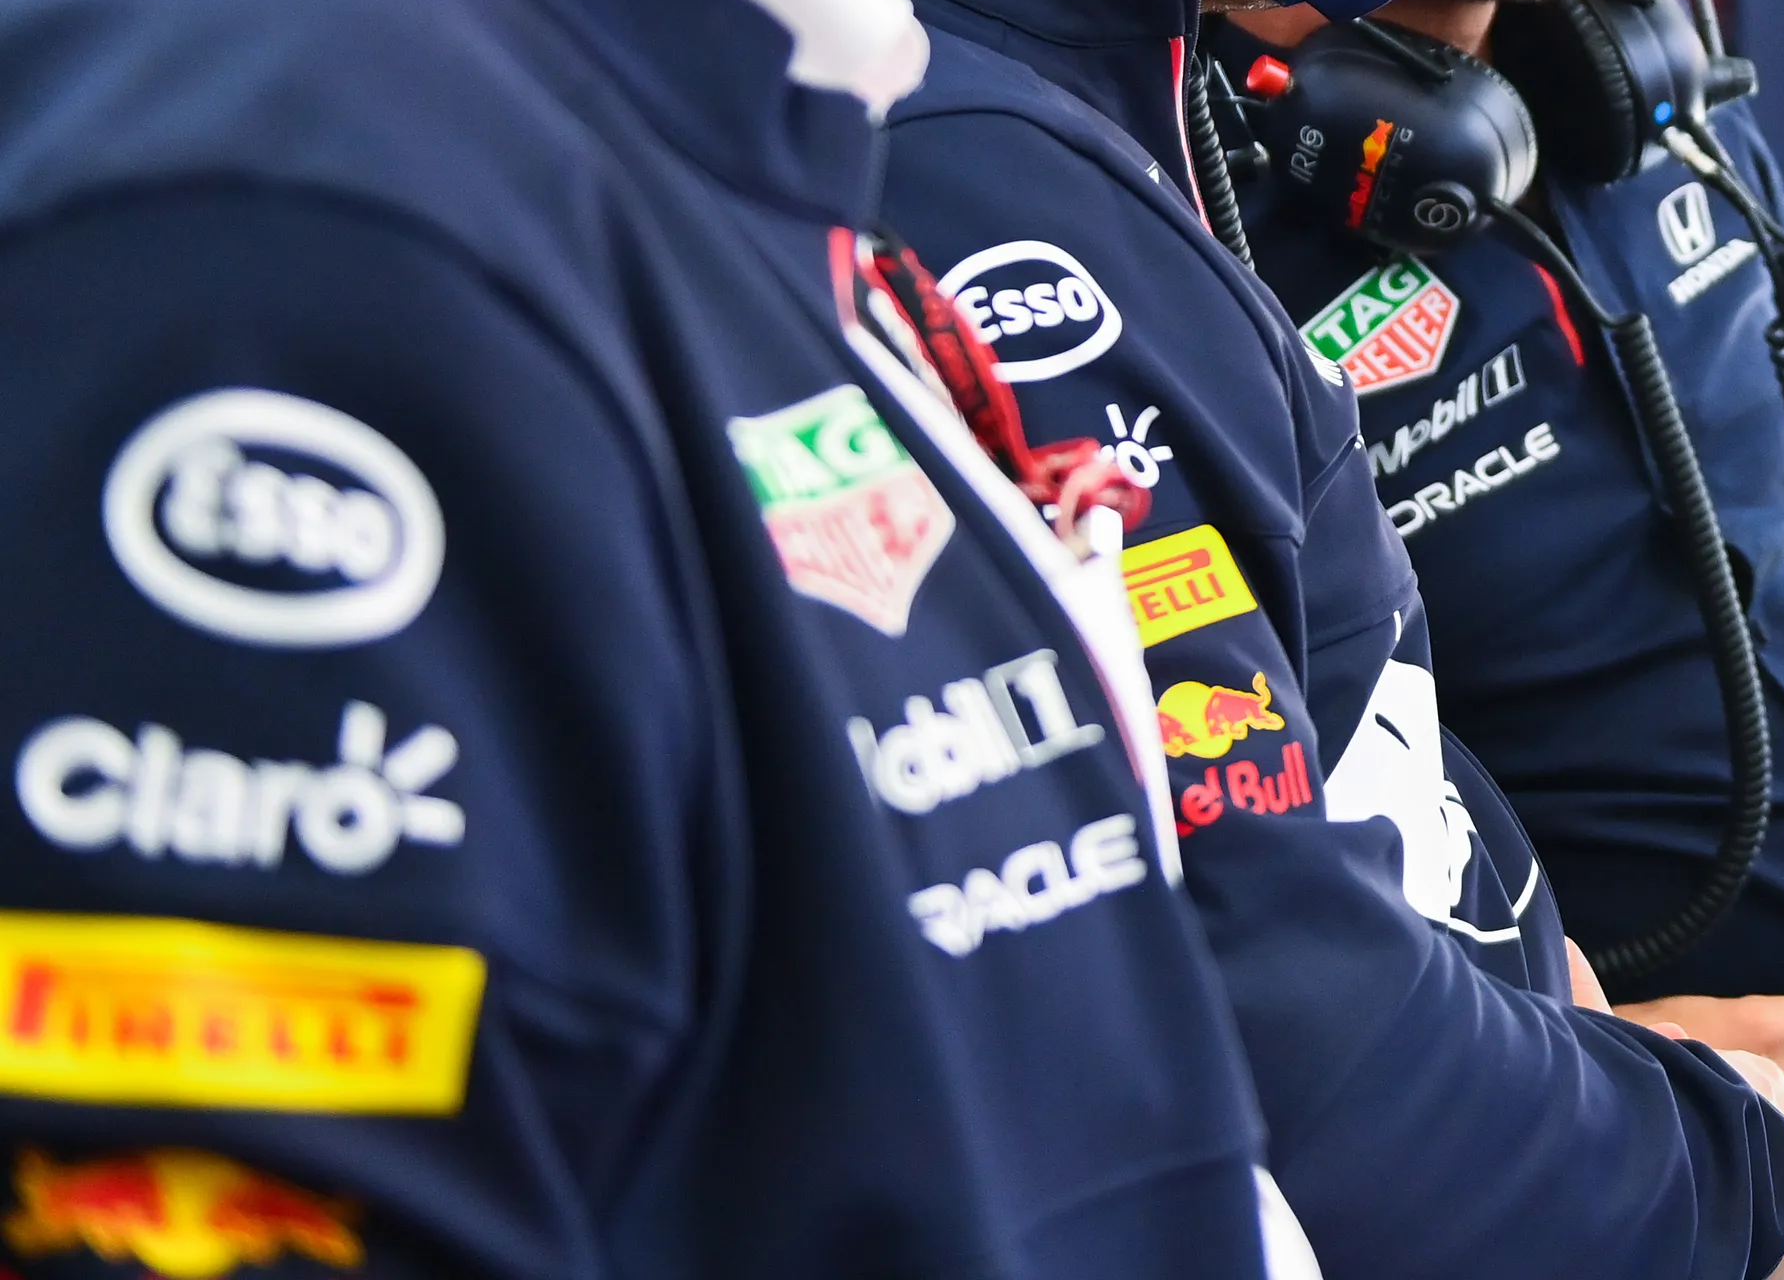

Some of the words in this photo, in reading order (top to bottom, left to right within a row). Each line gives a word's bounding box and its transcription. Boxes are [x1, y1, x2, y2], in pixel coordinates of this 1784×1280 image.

[1313, 262, 1421, 351] TAG
[1349, 290, 1448, 385] HEUER
[1368, 372, 1479, 478] Mobil
[1386, 422, 1561, 537] ORACLE
[15, 715, 402, 876] Claro
[1172, 766, 1224, 837] ed
[1226, 741, 1312, 816] Bull
